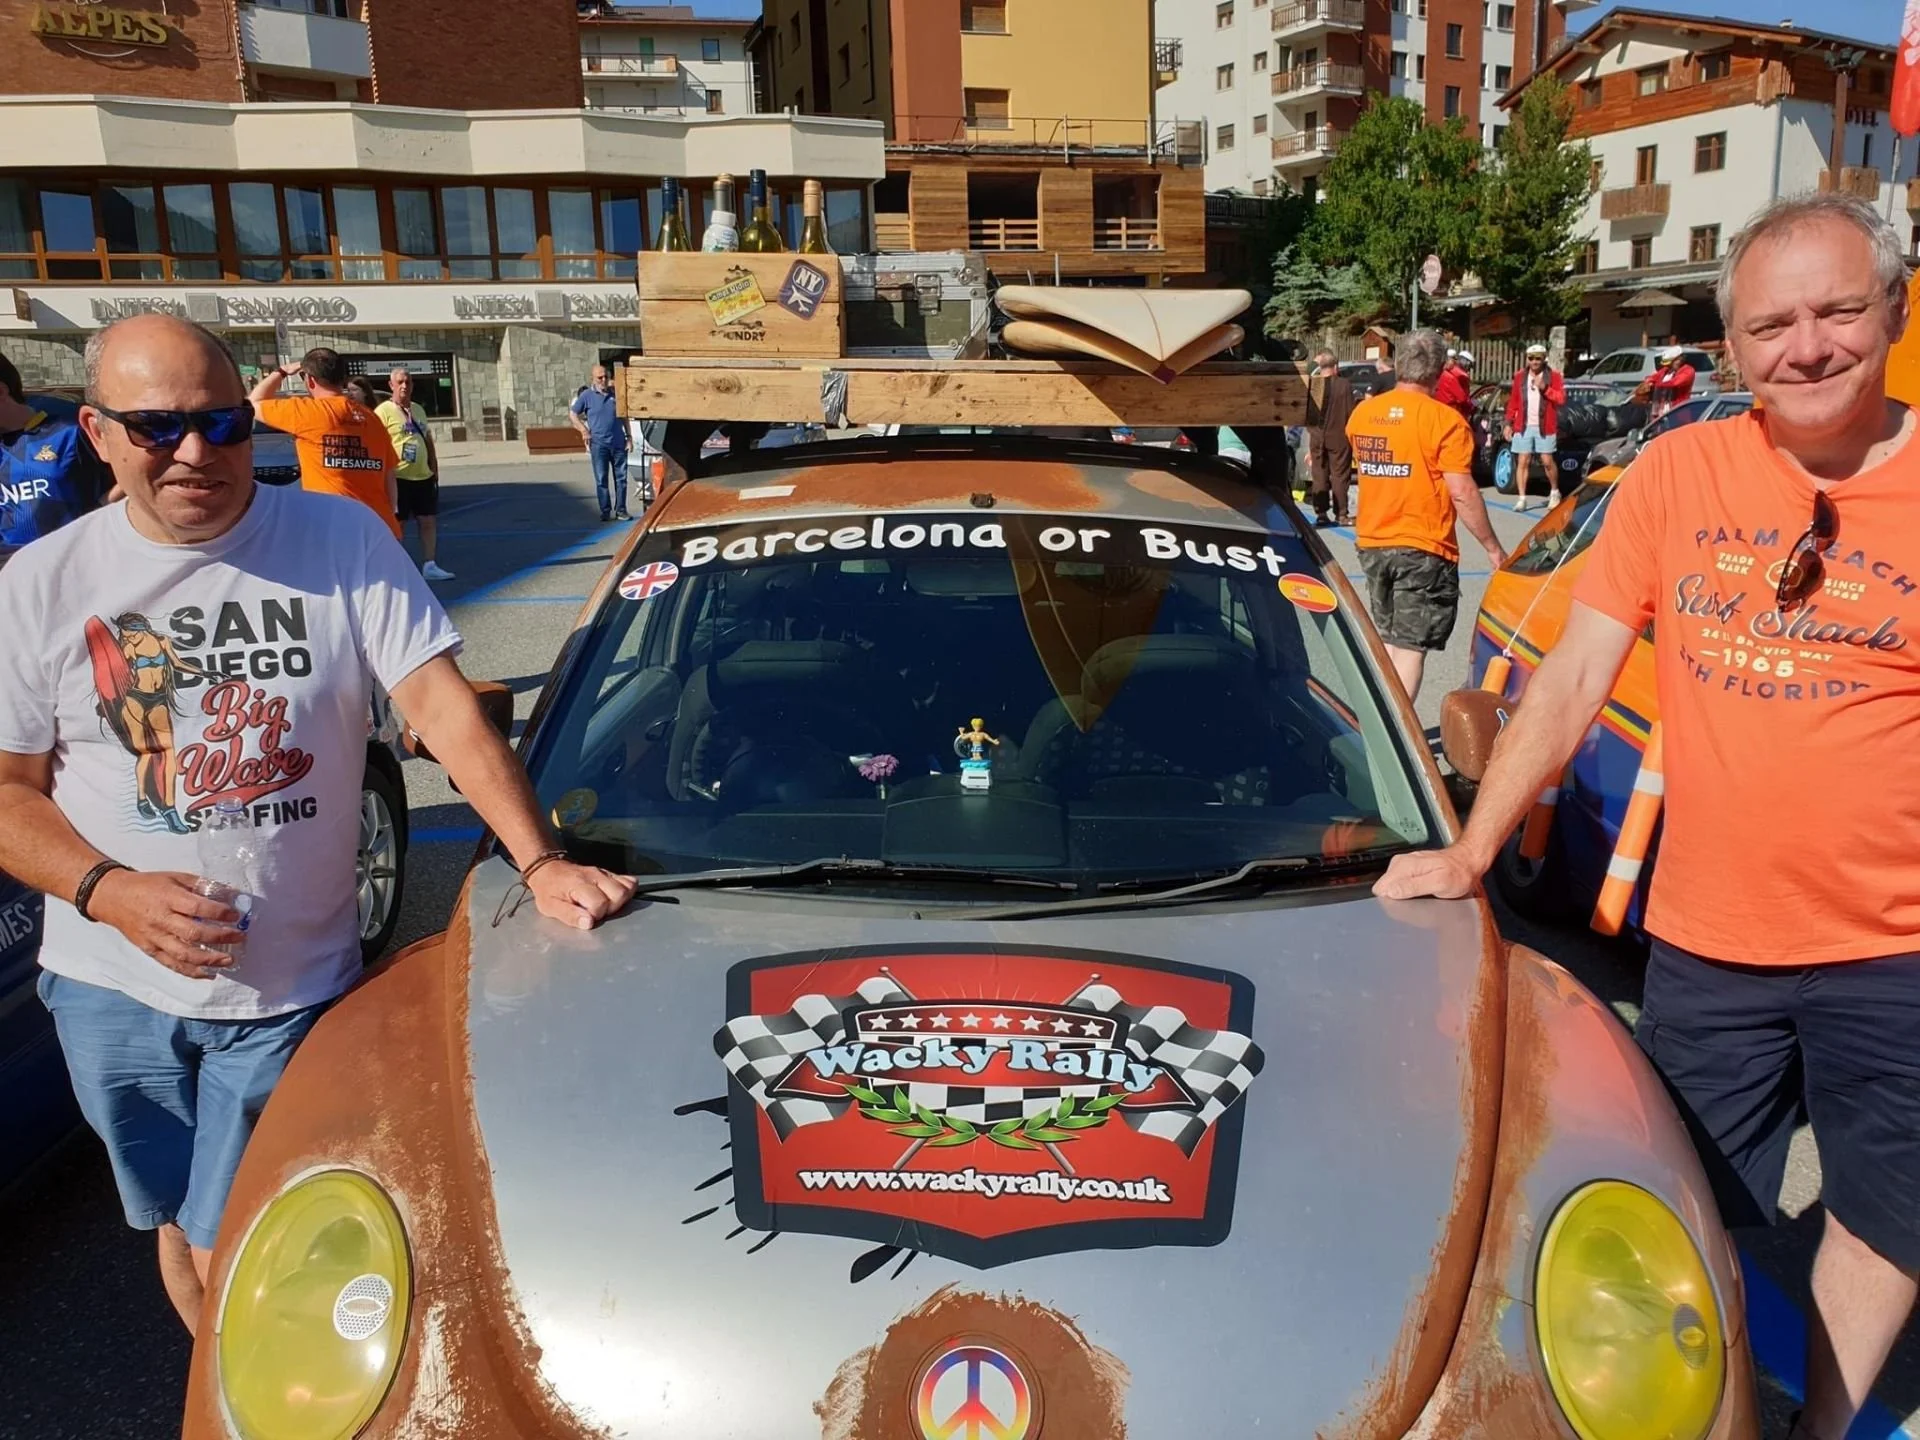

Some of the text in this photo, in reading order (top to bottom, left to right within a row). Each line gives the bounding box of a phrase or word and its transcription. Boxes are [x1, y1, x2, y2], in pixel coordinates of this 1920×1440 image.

[31, 3, 168, 45] ALPES
[796, 267, 821, 292] NY
[224, 296, 355, 322] SANPAOLO
[453, 294, 538, 319] INTESA
[324, 436, 360, 446] THIS IS
[324, 447, 367, 457] FOR THE
[1374, 438, 1385, 449] IS
[324, 457, 382, 470] LIFESAVERS
[1370, 451, 1392, 462] THE
[0, 478, 51, 505] NER
[682, 517, 1287, 577] Barcelona or Bust
[1695, 526, 1779, 549] PALM
[1715, 562, 1750, 575] MARK
[1718, 552, 1756, 566] TRADE
[1824, 577, 1867, 593] SINCE
[168, 597, 308, 652] SAN
[1674, 573, 1748, 625] Surf
[1750, 599, 1908, 651] Shack
[175, 646, 312, 690] DIEGO
[1723, 647, 1795, 678] 1965
[1799, 650, 1833, 662] WAY
[201, 680, 292, 753] Big
[177, 735, 314, 798] Wave
[806, 1038, 1164, 1093] Wacky Rally
[799, 1168, 1172, 1202] www.wackyrally.co.uk
